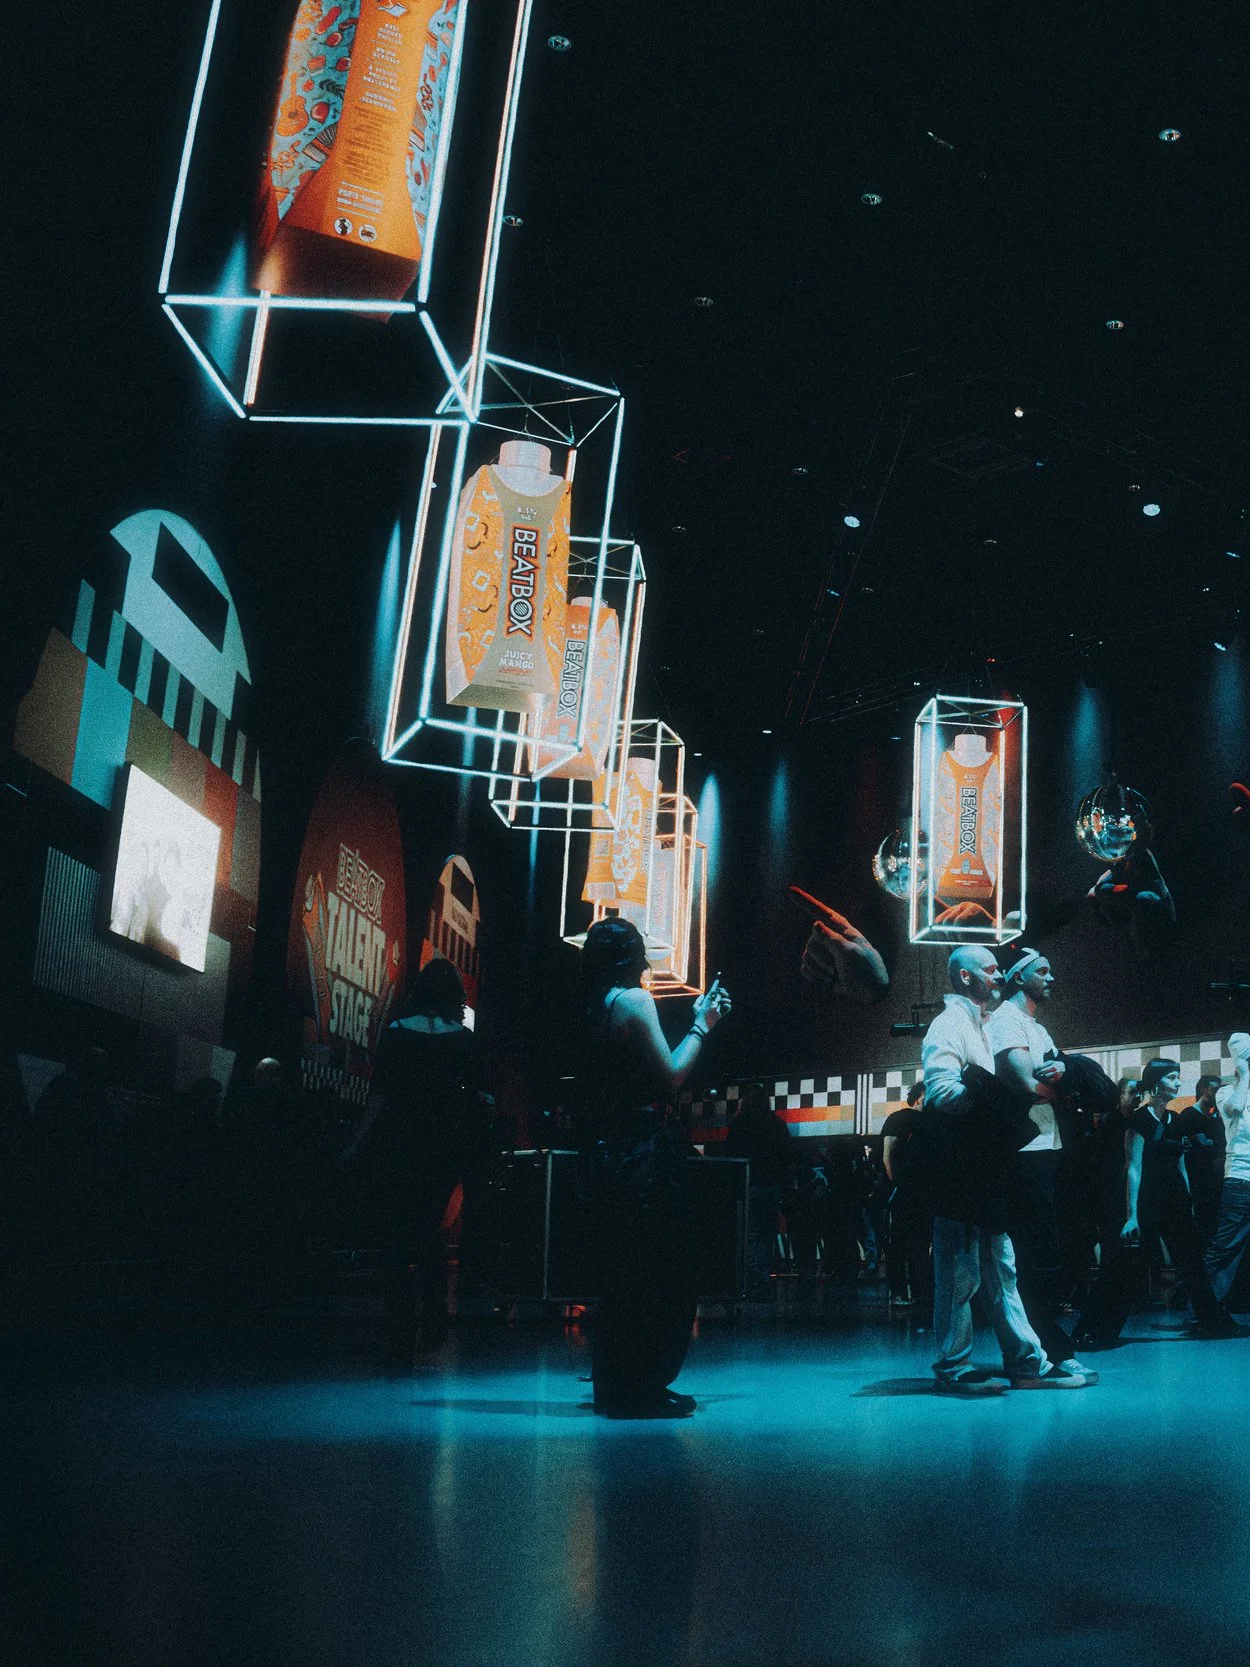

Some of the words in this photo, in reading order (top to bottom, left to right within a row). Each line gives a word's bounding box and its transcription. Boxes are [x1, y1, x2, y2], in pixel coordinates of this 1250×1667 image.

[508, 527, 539, 636] BEATBOX
[499, 657, 535, 669] MANGO
[503, 649, 534, 661] JUICY
[558, 639, 585, 718] BEATBOX
[959, 787, 978, 855] BEATBOX
[337, 843, 386, 925] BEATBOX
[325, 891, 386, 998] TALENT
[329, 977, 373, 1049] STAGE
